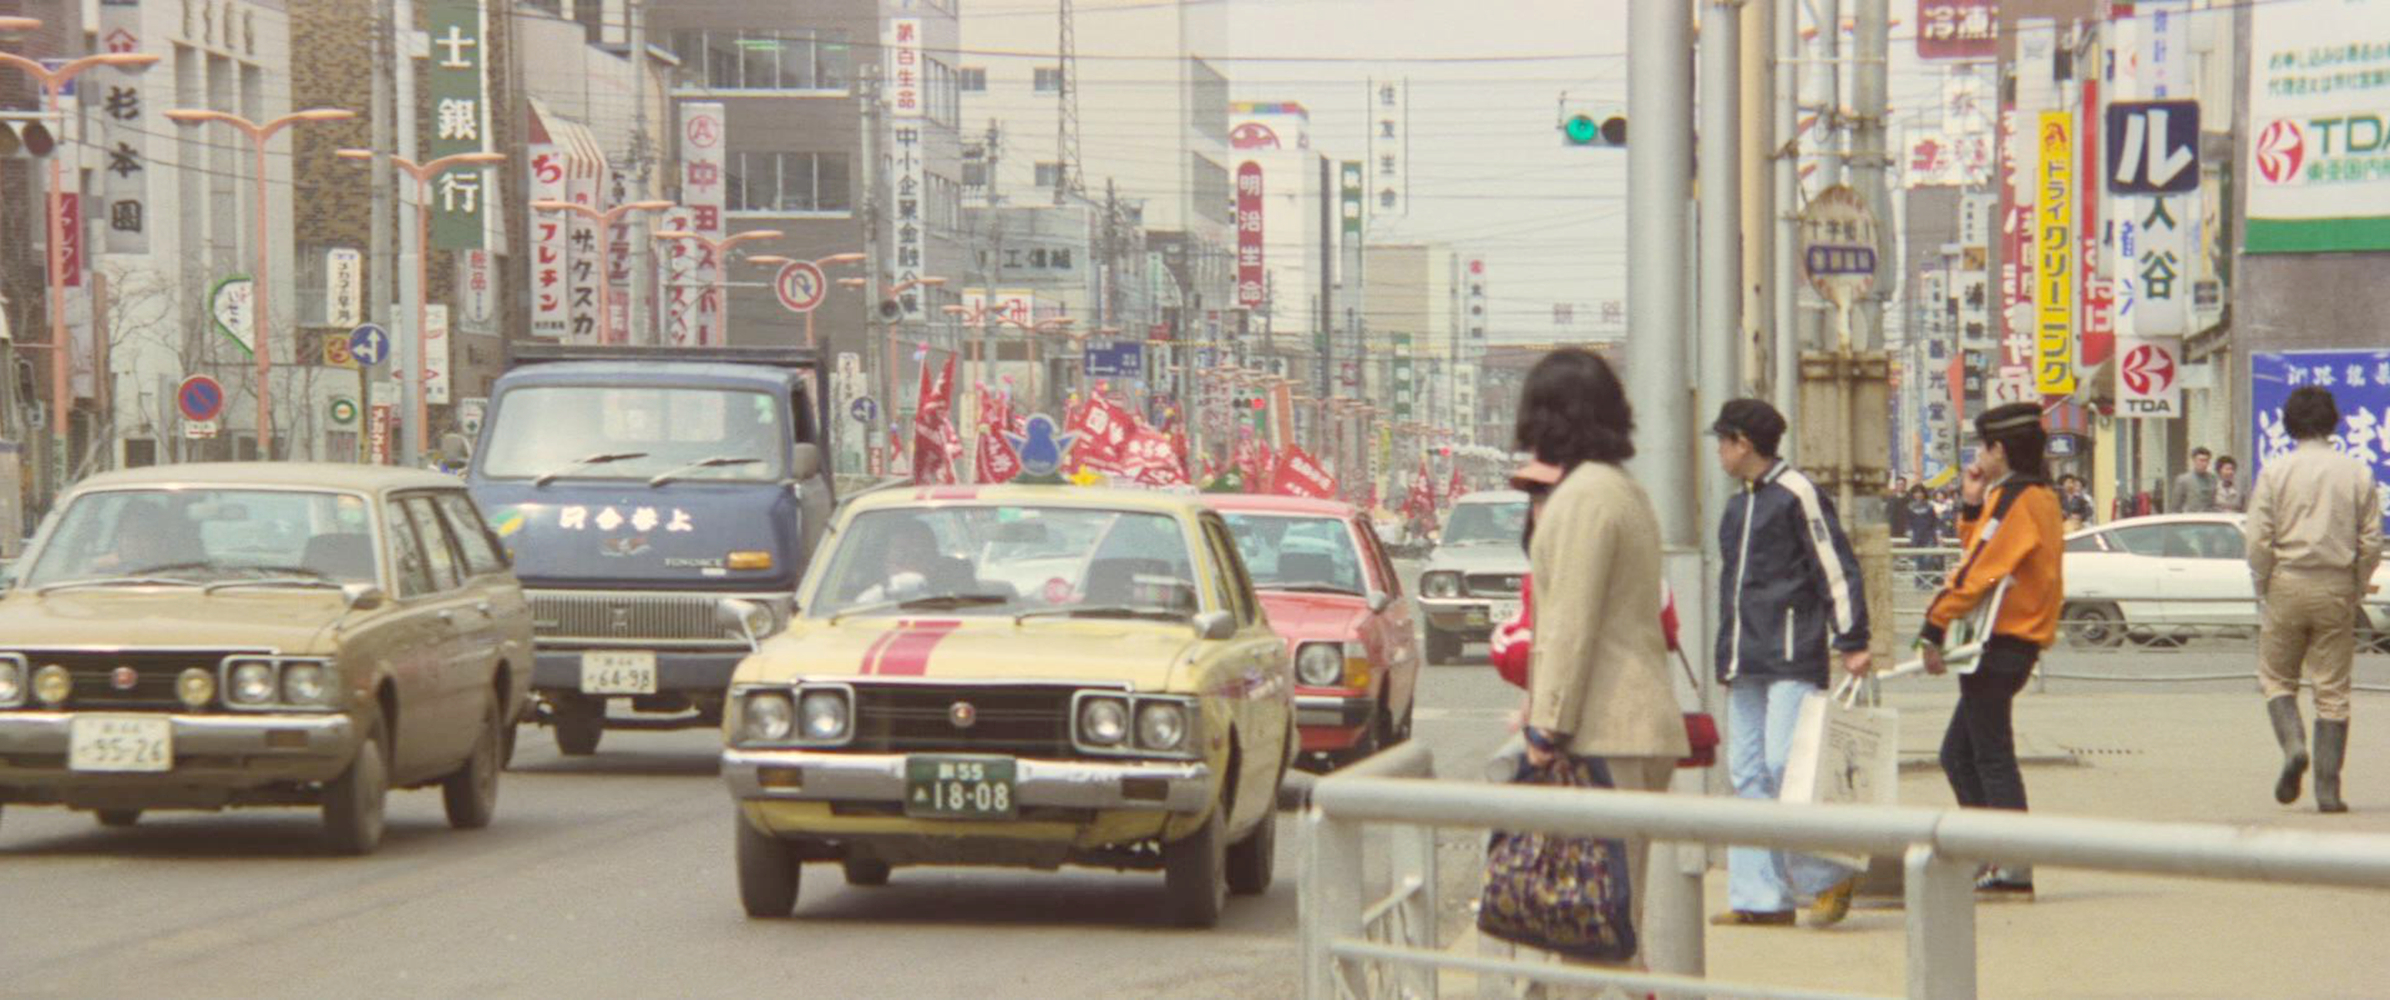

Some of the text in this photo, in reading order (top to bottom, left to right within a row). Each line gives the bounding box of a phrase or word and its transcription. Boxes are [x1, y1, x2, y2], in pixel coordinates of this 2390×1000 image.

[435, 25, 480, 213] 士銀行
[2114, 108, 2194, 188] ル
[1239, 173, 1261, 302] 明治生命
[2041, 158, 2068, 386] ドライクリーニング
[2125, 399, 2171, 413] TDA
[935, 781, 1009, 811] 18-08
